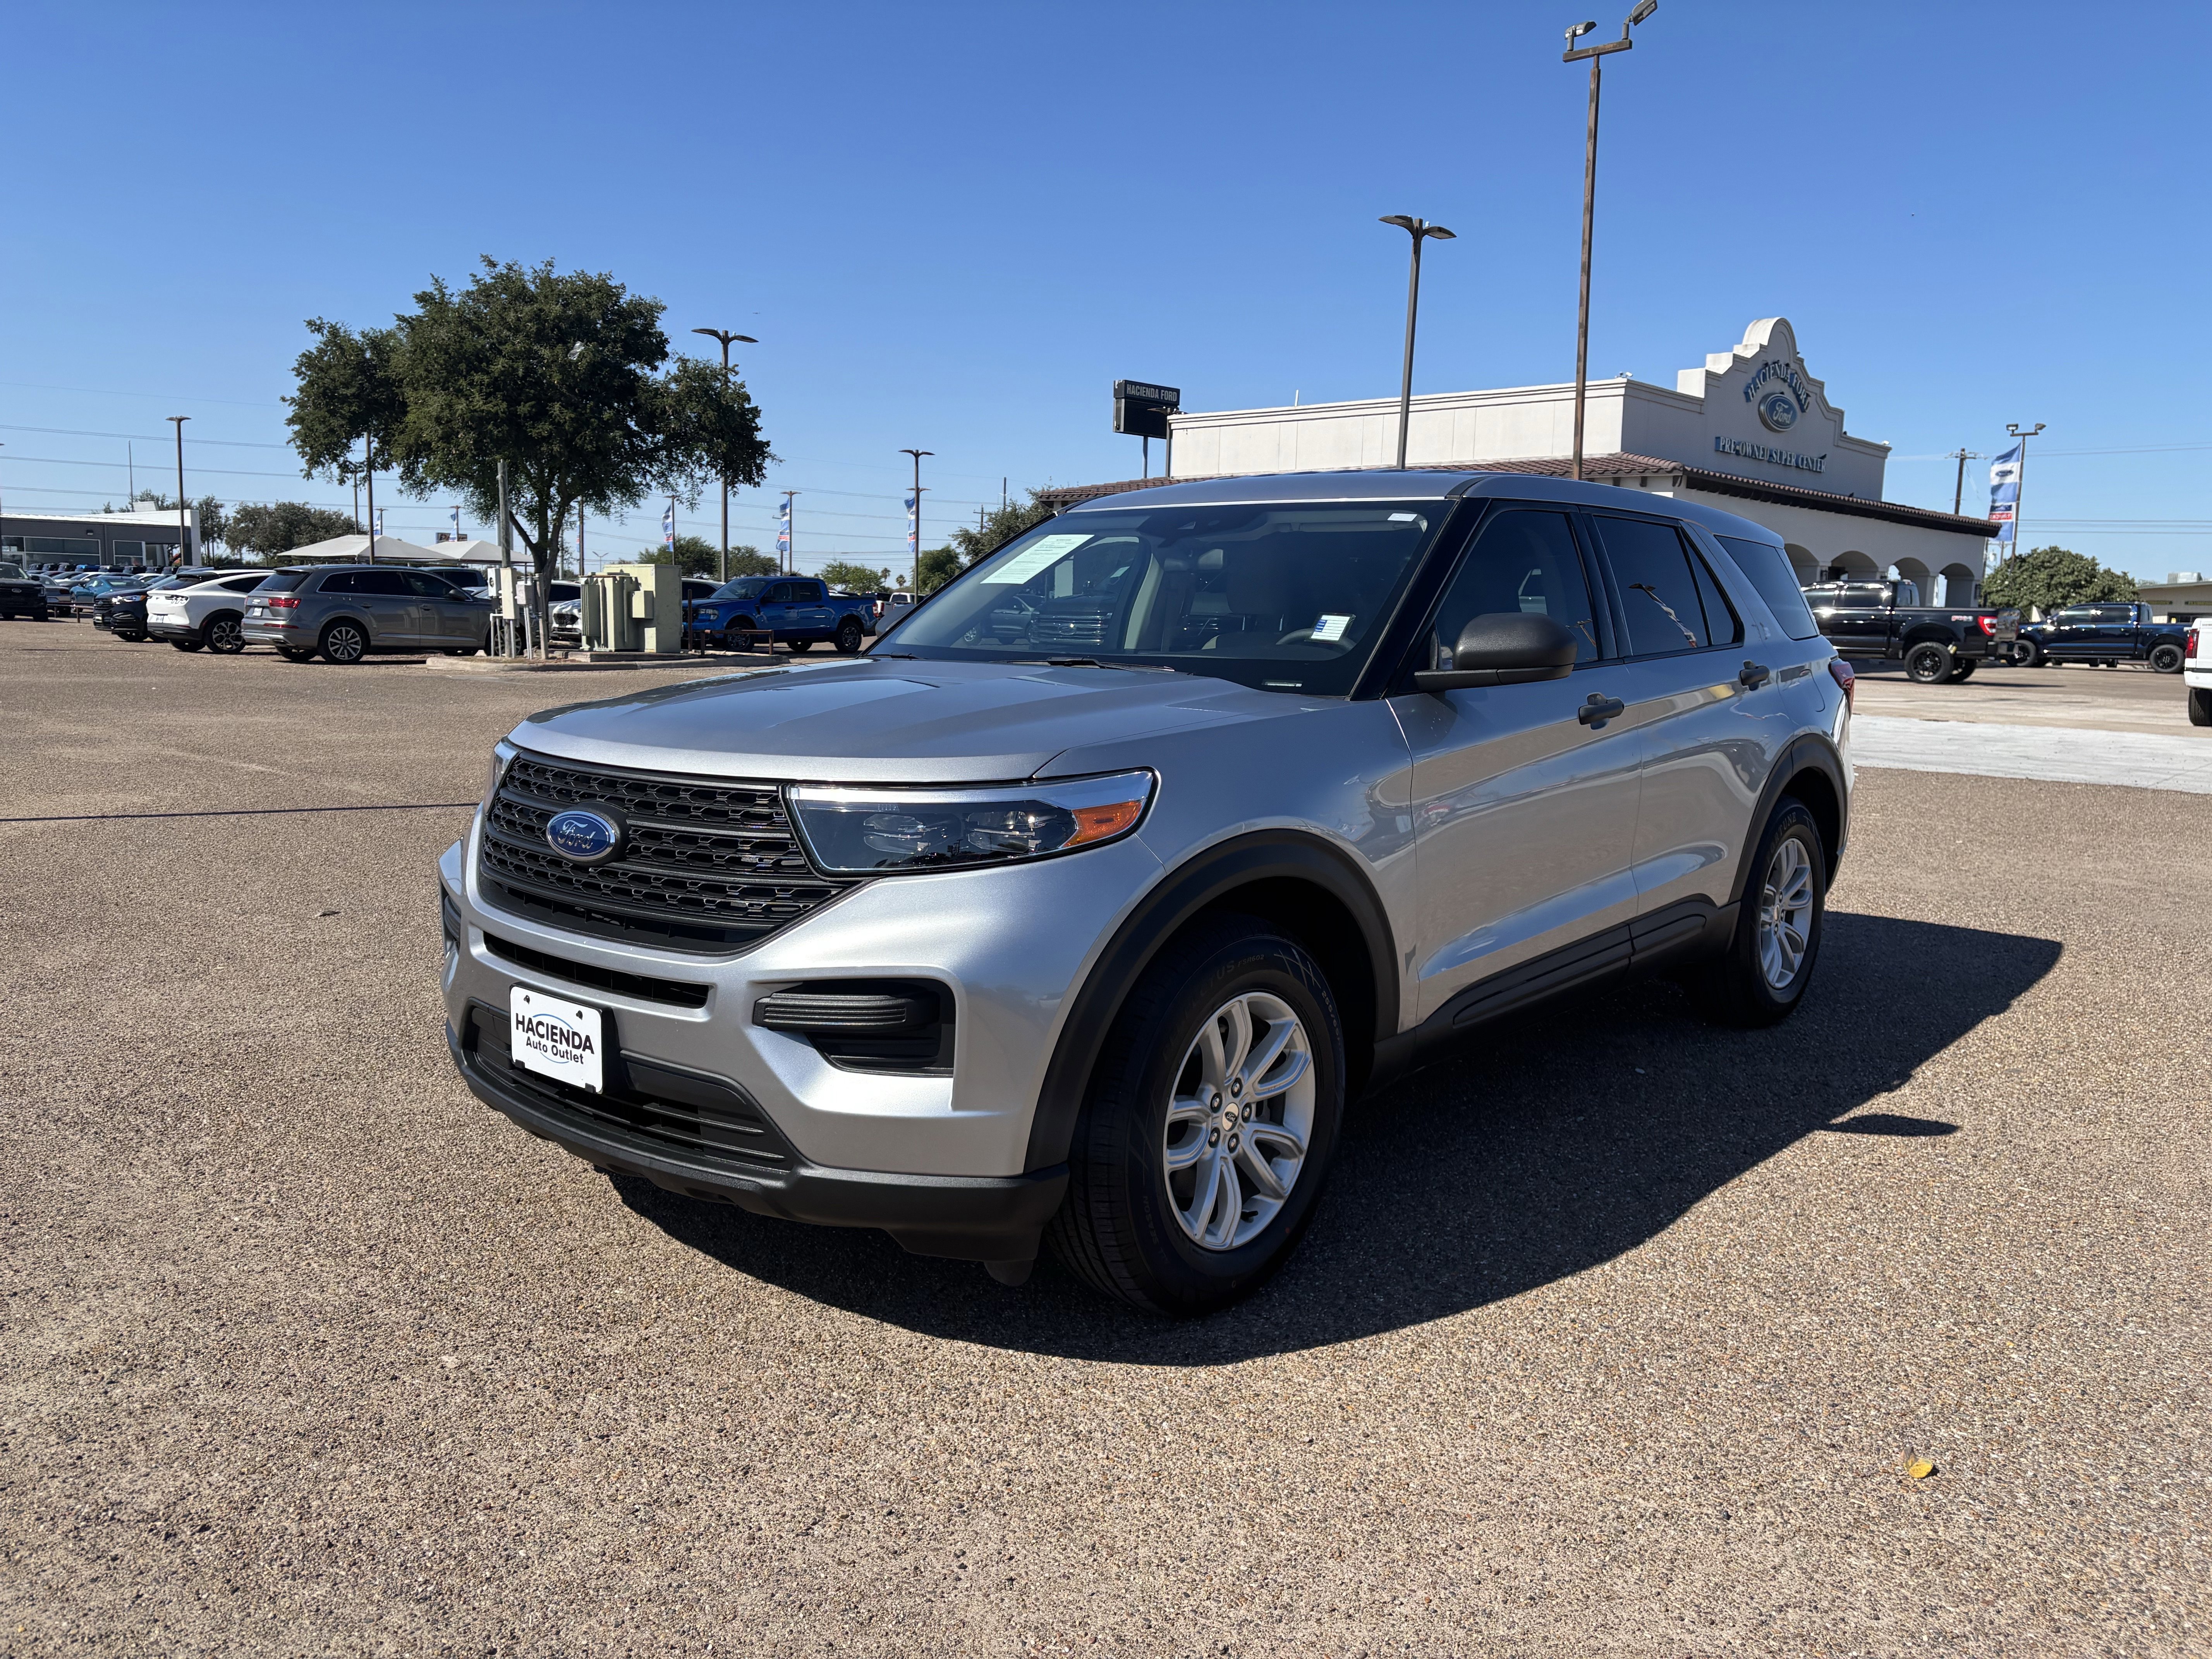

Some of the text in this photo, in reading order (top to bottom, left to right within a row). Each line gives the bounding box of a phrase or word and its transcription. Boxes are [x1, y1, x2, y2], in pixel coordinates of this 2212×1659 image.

[1127, 384, 1177, 402] HACIENDA FORD
[1748, 363, 1791, 401] HACIENDA
[1773, 402, 1792, 424] Ford
[1719, 436, 1826, 473] PRE-OWNED SUPER CENTER
[557, 819, 596, 849] Ford
[515, 1013, 595, 1055] HACIENDA
[526, 1036, 584, 1065] Auto Outlet
